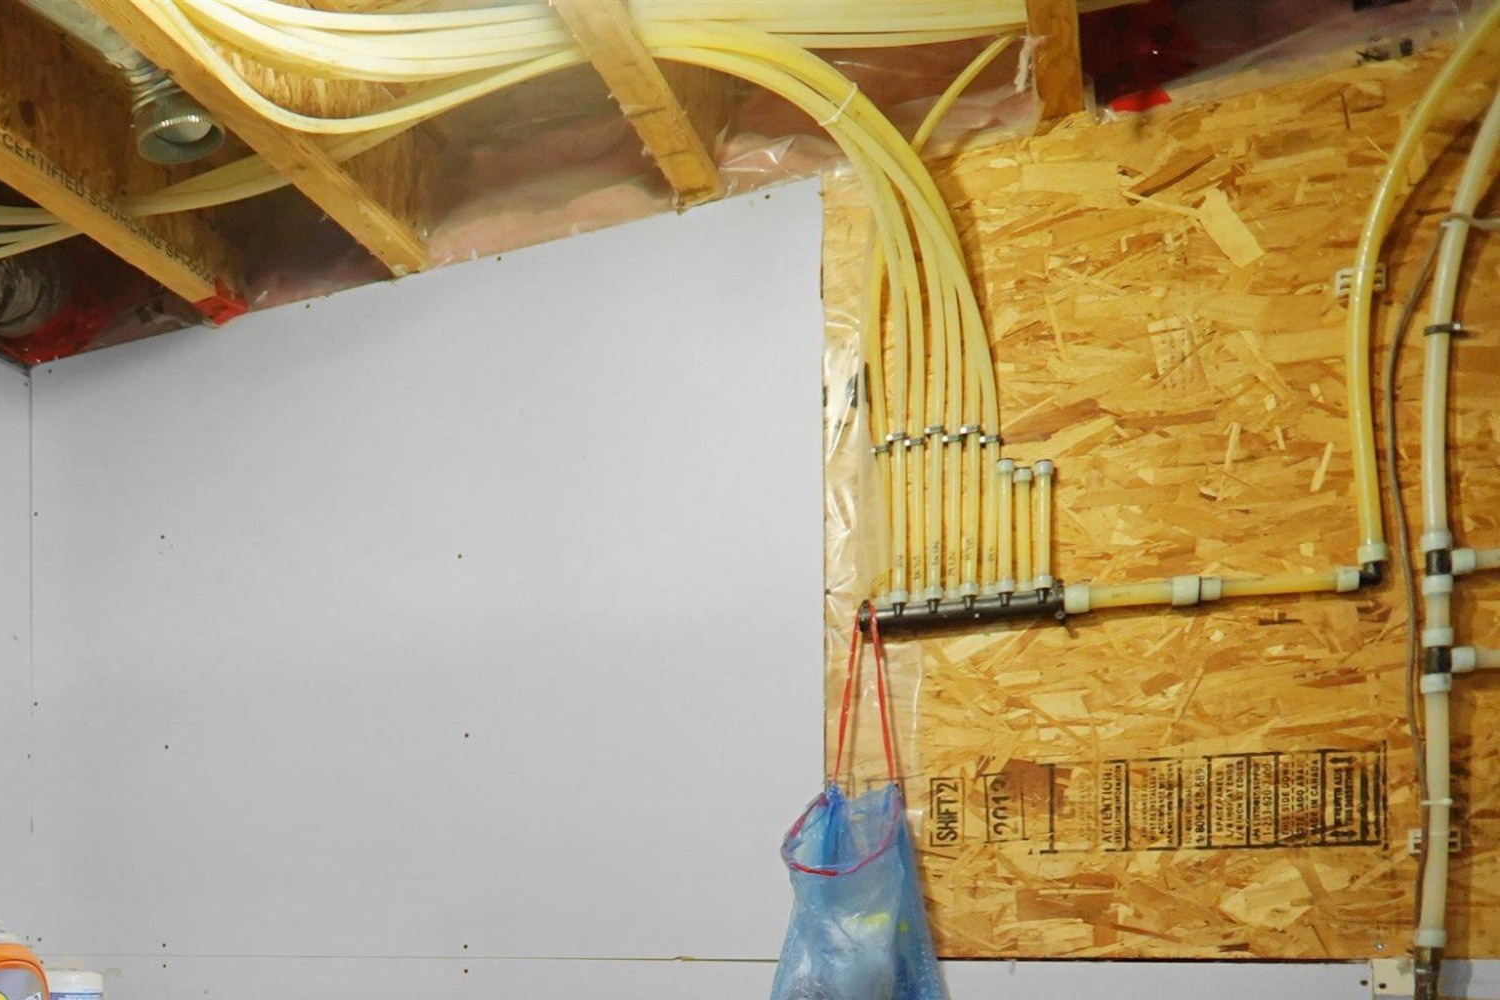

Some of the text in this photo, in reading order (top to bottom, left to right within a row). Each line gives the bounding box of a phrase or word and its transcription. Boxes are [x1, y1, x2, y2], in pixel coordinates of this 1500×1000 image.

[2, 132, 85, 198] CERTIFIED
[1282, 791, 1290, 812] SIDE
[1311, 759, 1319, 796] CANADA
[936, 782, 958, 841] SHIFT 2
